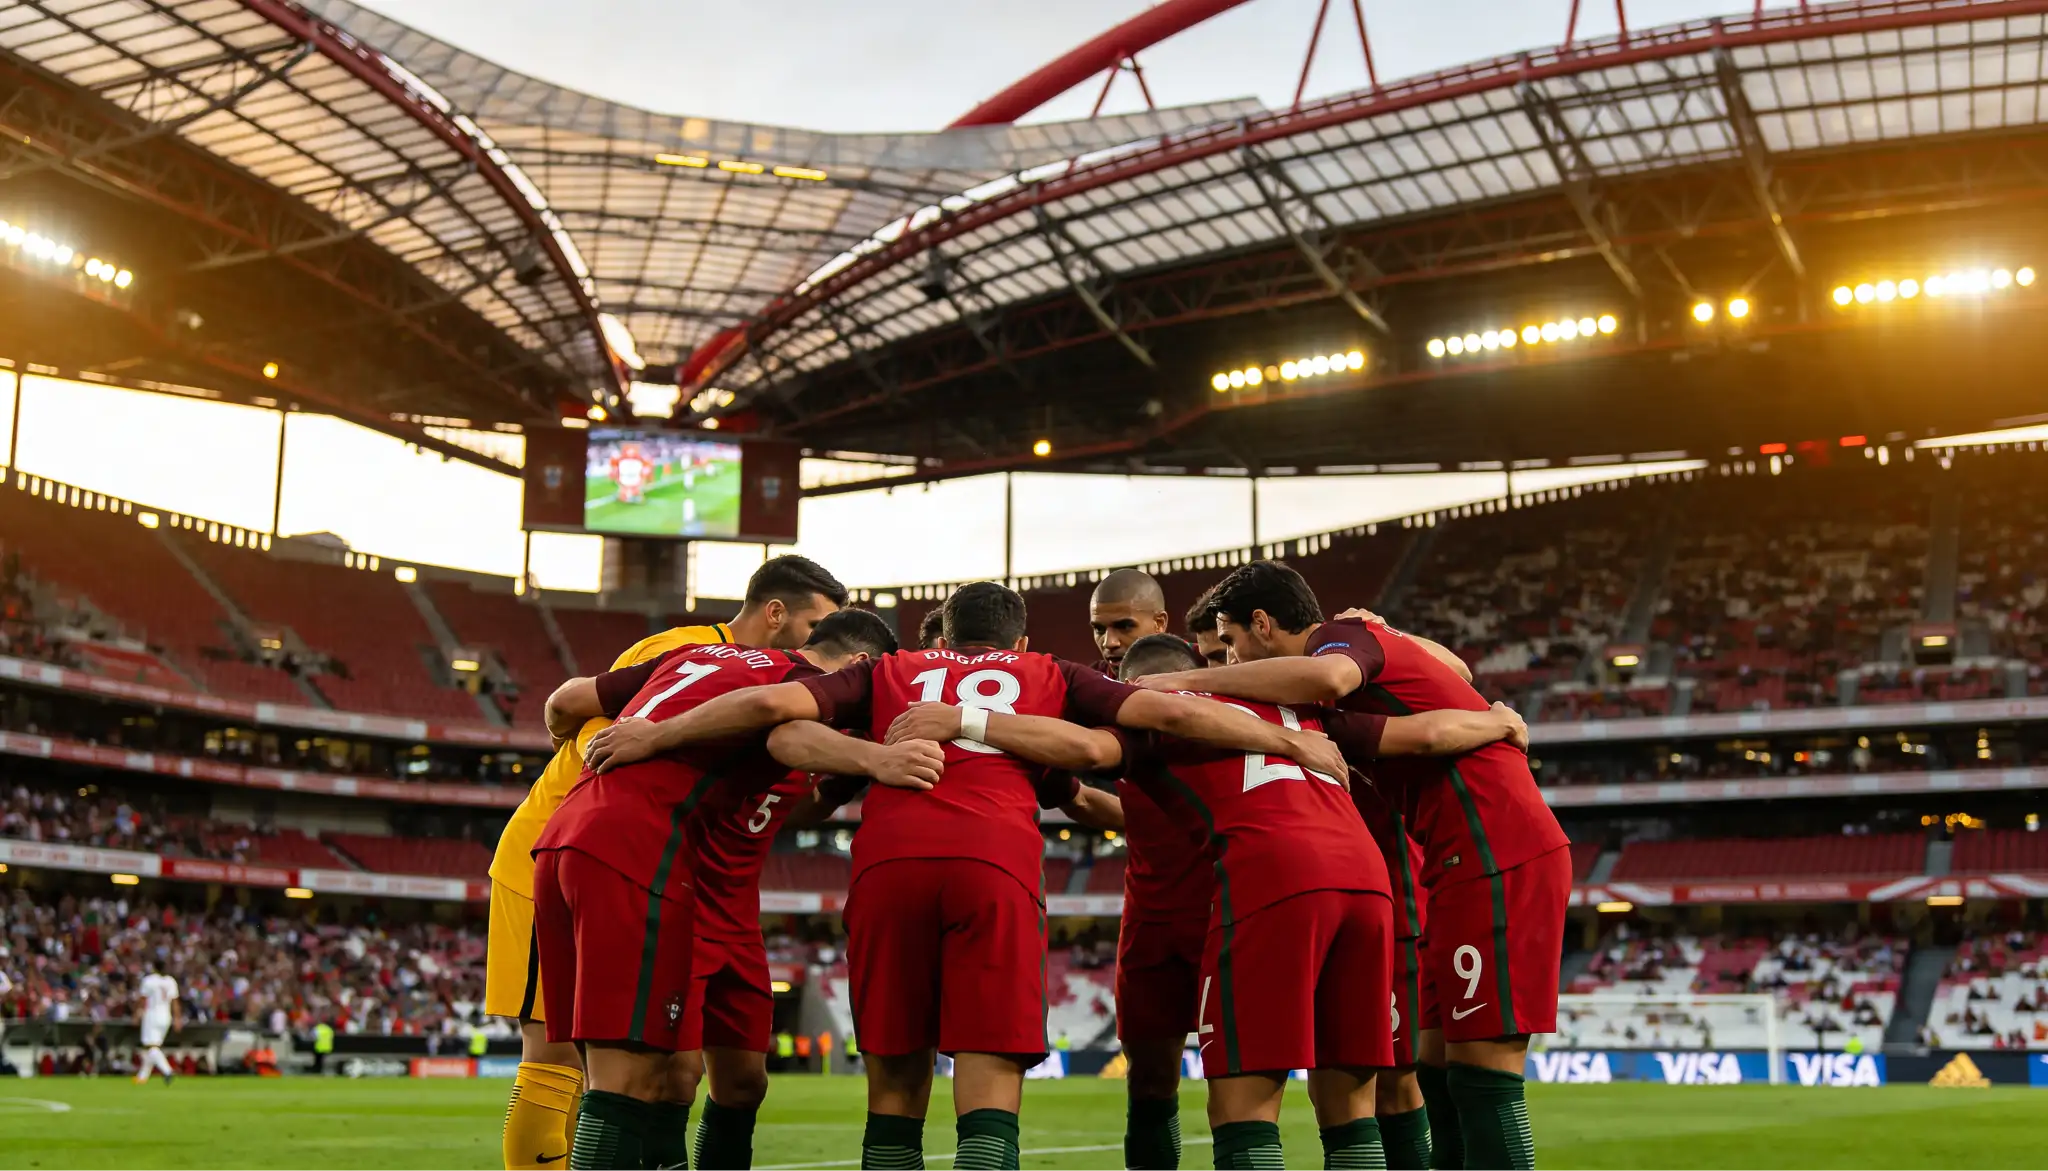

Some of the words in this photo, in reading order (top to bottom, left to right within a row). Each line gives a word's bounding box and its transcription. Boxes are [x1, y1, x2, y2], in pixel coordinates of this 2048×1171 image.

[748, 793, 782, 833] 5
[1453, 944, 1483, 999] 9
[1530, 1052, 1612, 1083] VISA
[1656, 1052, 1742, 1084] VISA
[1788, 1053, 1881, 1087] VISA
